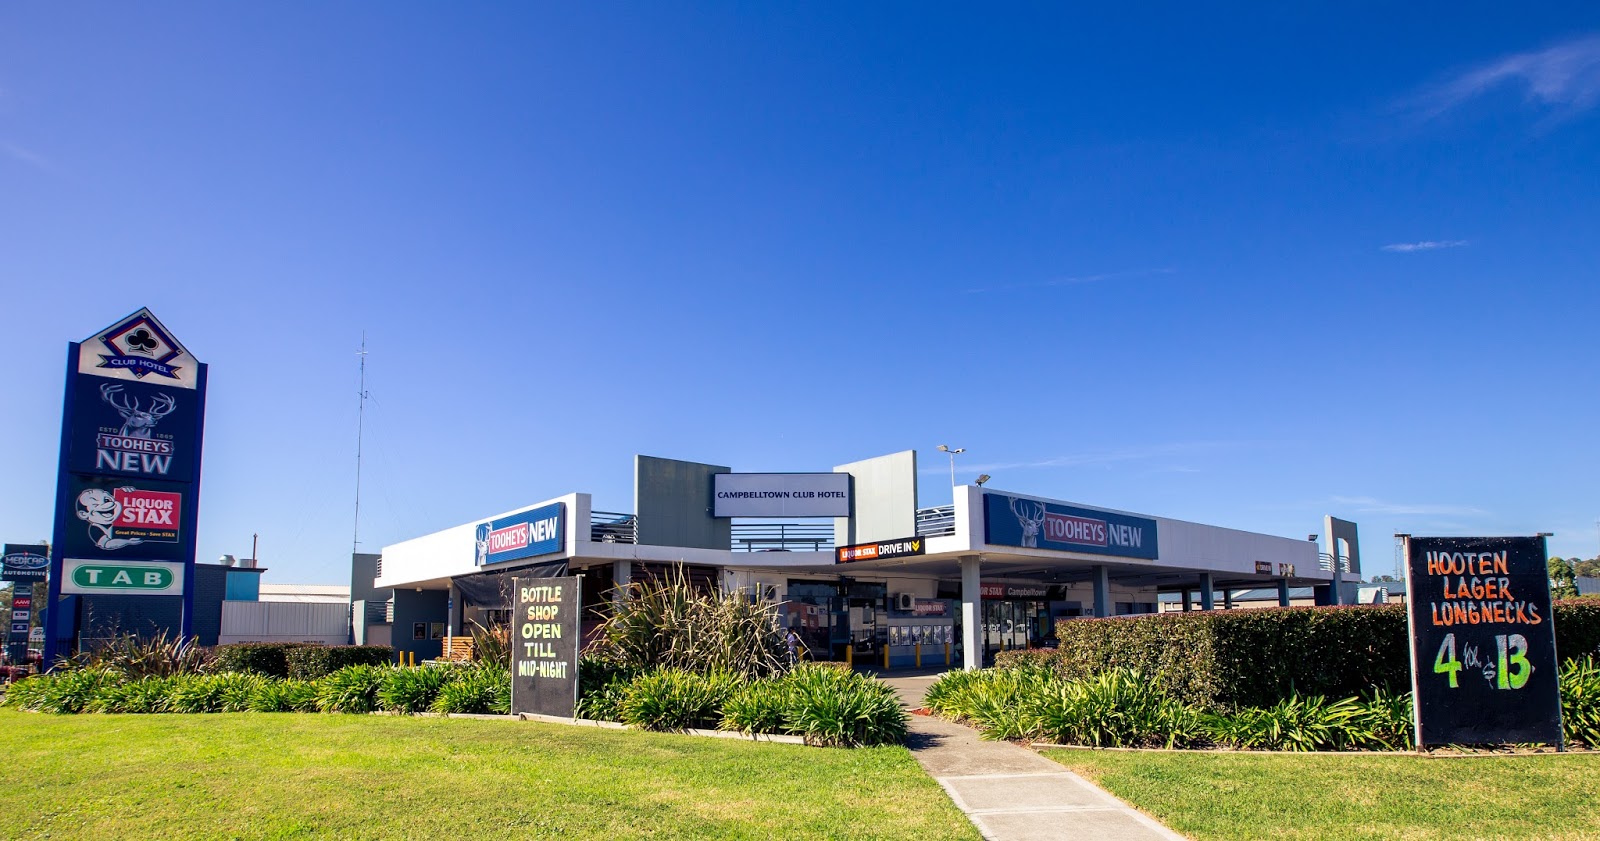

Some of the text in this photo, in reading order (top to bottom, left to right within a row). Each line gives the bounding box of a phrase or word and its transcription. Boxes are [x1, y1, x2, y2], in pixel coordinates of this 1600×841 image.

[110, 358, 169, 373] CLUB HOTEL
[102, 436, 170, 453] TOOHEYS
[95, 449, 173, 475] NEW
[123, 497, 173, 510] LIQUOR
[717, 491, 790, 499] CAMPBELLTOWN
[792, 491, 815, 499] CLUB
[122, 508, 173, 525] STAX
[491, 516, 558, 550] TOOHEYS NEW
[1047, 517, 1143, 548] TOOHEYS NEW
[842, 541, 912, 559] LIQUOR STAX DRIVE IN
[1426, 550, 1509, 576] HOOTEN
[85, 569, 162, 585] TAB
[521, 586, 562, 603] BOTTLE
[989, 587, 1003, 596] STAX
[1008, 587, 1047, 598] Campbelltown
[1443, 576, 1515, 601] LAGER
[527, 605, 559, 621] SHOP
[914, 604, 944, 612] LIQUOR STAX
[1431, 600, 1542, 626] LONGNECKS
[521, 623, 562, 639] OPEN
[524, 642, 556, 658] TILL
[1433, 632, 1462, 688] 4
[518, 660, 568, 679] MID-NIGHT
